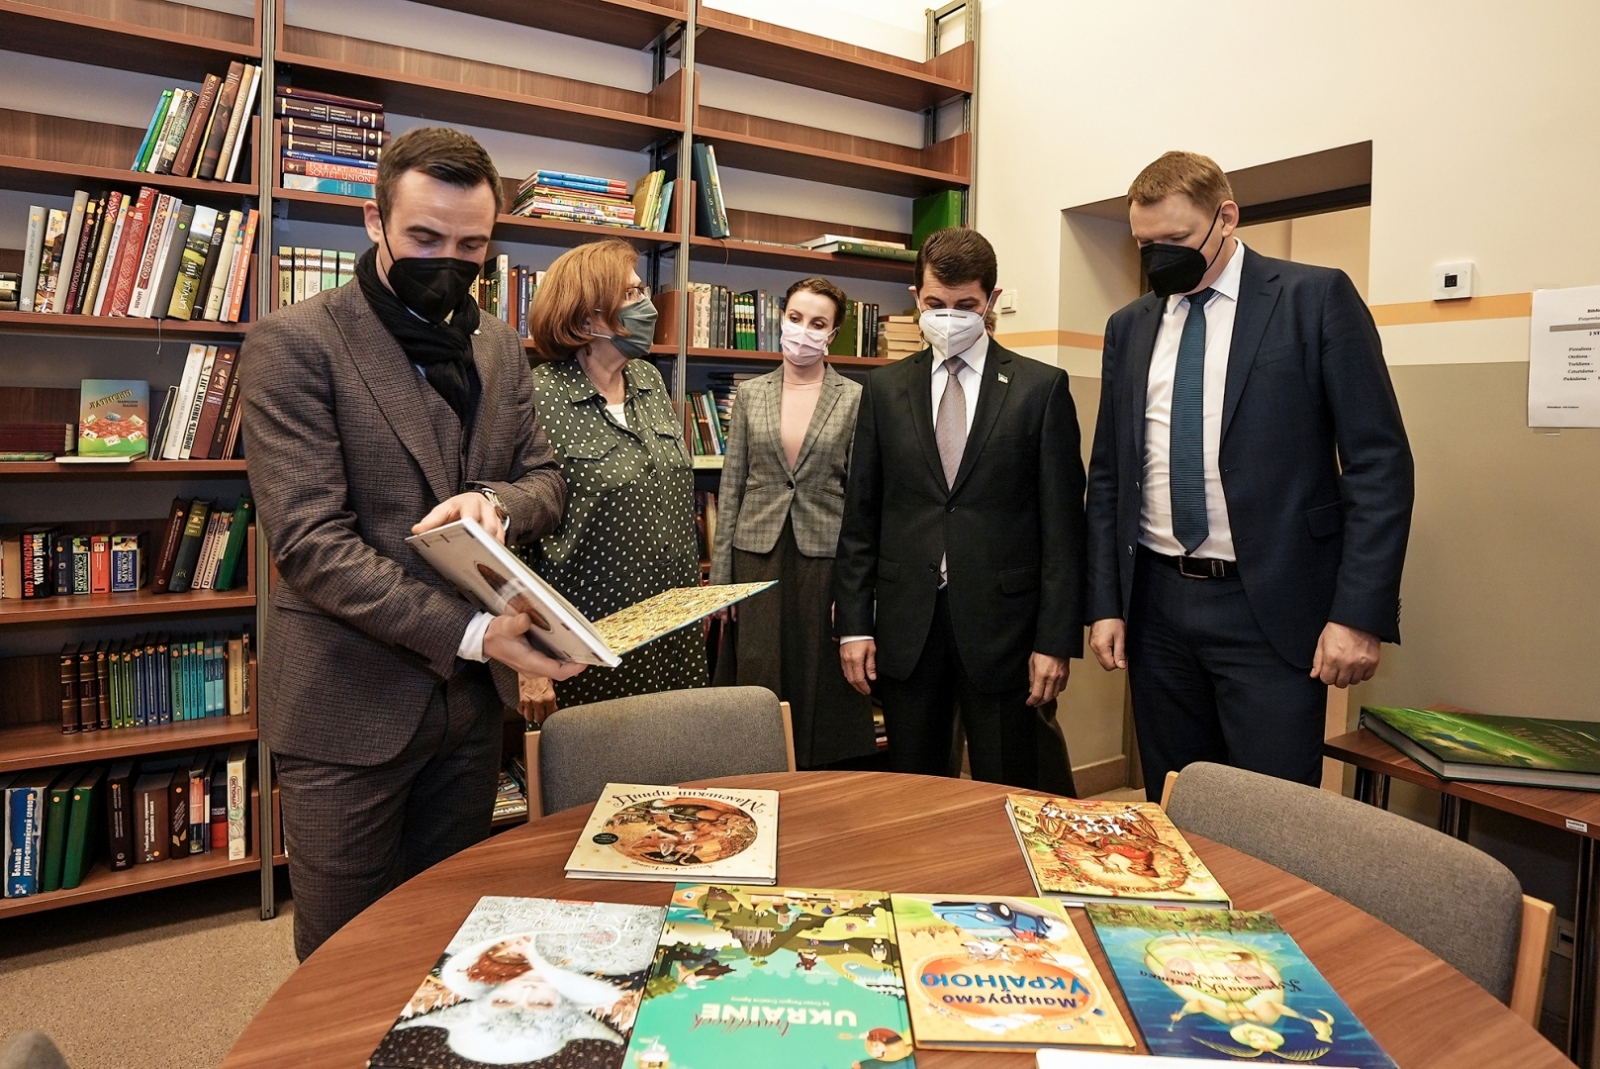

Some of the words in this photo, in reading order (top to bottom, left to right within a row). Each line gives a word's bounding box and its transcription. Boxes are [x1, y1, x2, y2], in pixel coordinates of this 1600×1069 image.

[309, 169, 339, 180] SOVIET
[341, 173, 371, 182] UNION
[310, 162, 329, 171] FOLK
[77, 235, 88, 260] PASAULES
[177, 279, 193, 310] LATVIJA
[183, 421, 196, 450] ПОВІСТЬ
[190, 389, 204, 421] МИНУЛИХ
[199, 377, 208, 390] ЛІТ
[23, 534, 33, 578] ИНОСТРАННЫХ
[34, 557, 43, 584] СЛОВАРЬ
[24, 580, 33, 596] СЛОВ
[677, 790, 766, 814] Маленький
[1071, 823, 1125, 837] 100
[20, 818, 34, 876] русско-английский
[11, 847, 22, 876] Большой
[730, 996, 752, 1004] Agency
[942, 994, 1078, 1009] Мандруємо
[689, 1014, 790, 1038] travelbook
[699, 1003, 858, 1027] UKRAINE
